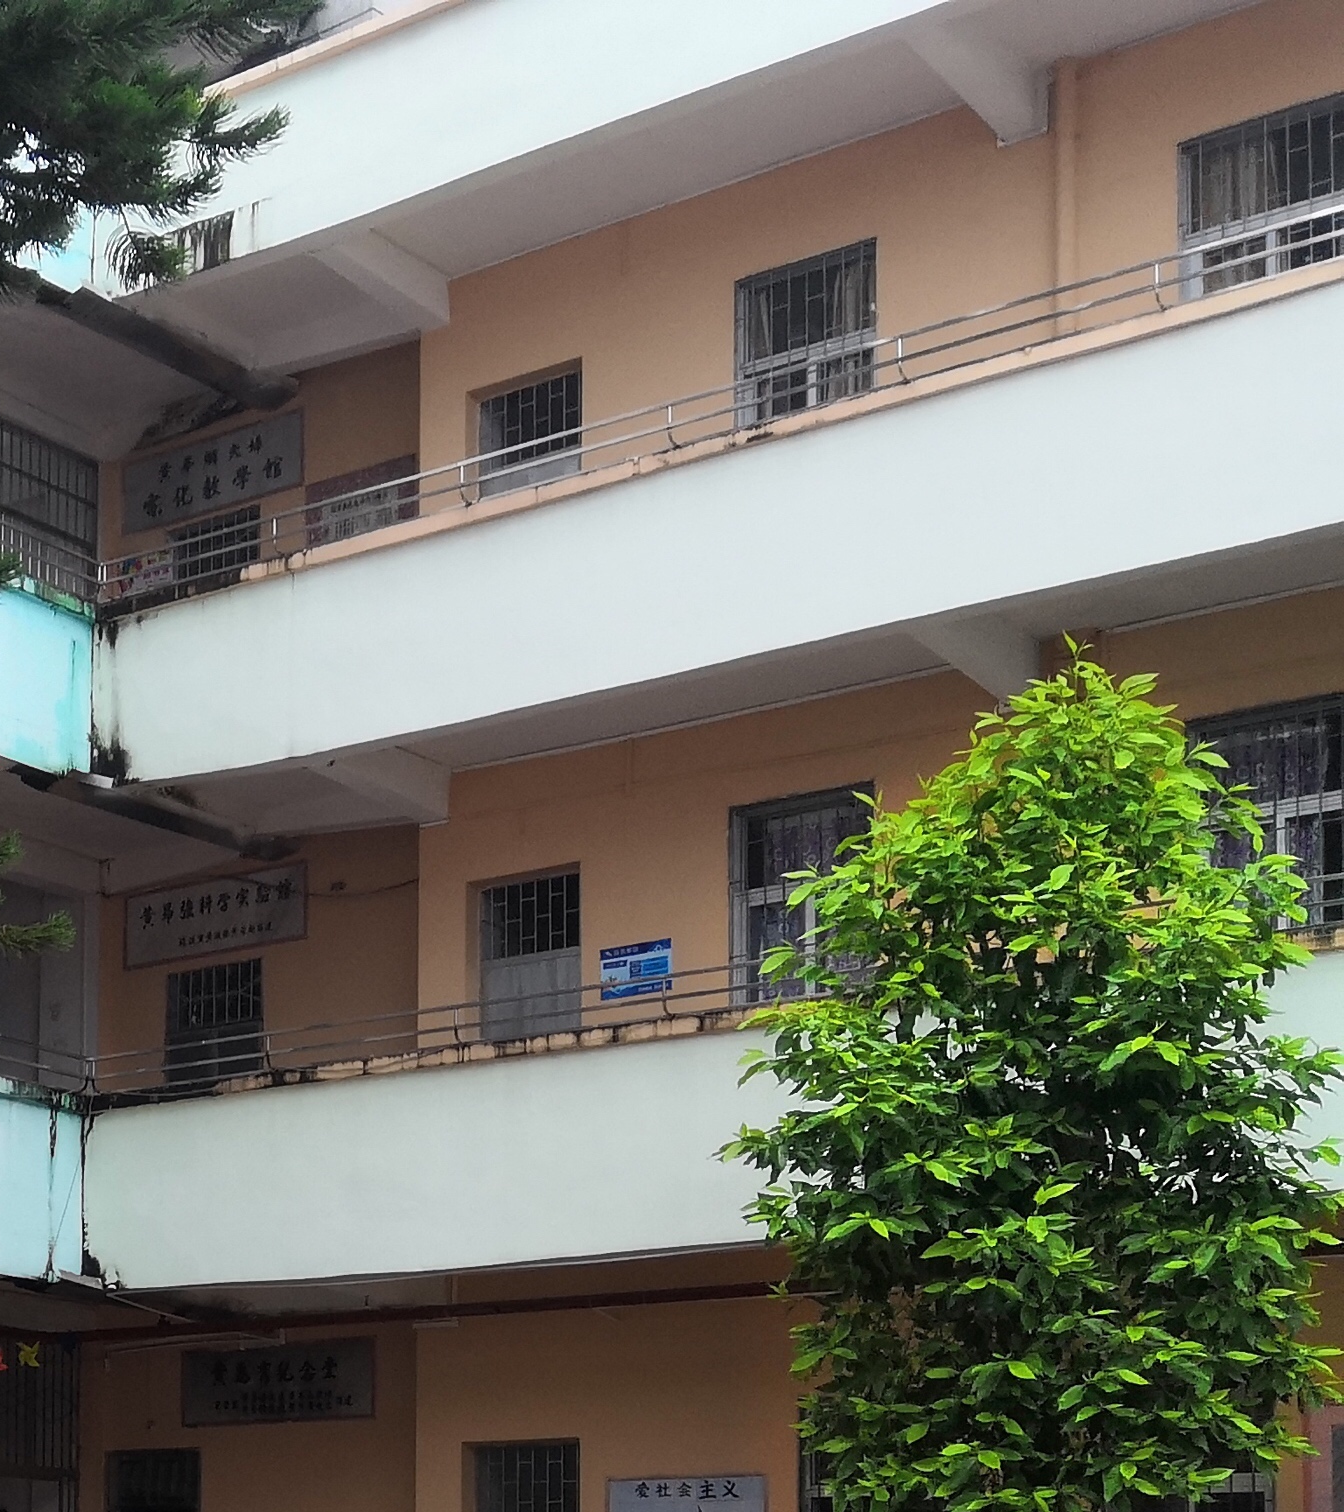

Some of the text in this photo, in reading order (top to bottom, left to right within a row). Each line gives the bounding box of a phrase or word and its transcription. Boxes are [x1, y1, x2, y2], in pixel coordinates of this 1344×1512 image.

[634, 1480, 740, 1500] 爱社会主义
